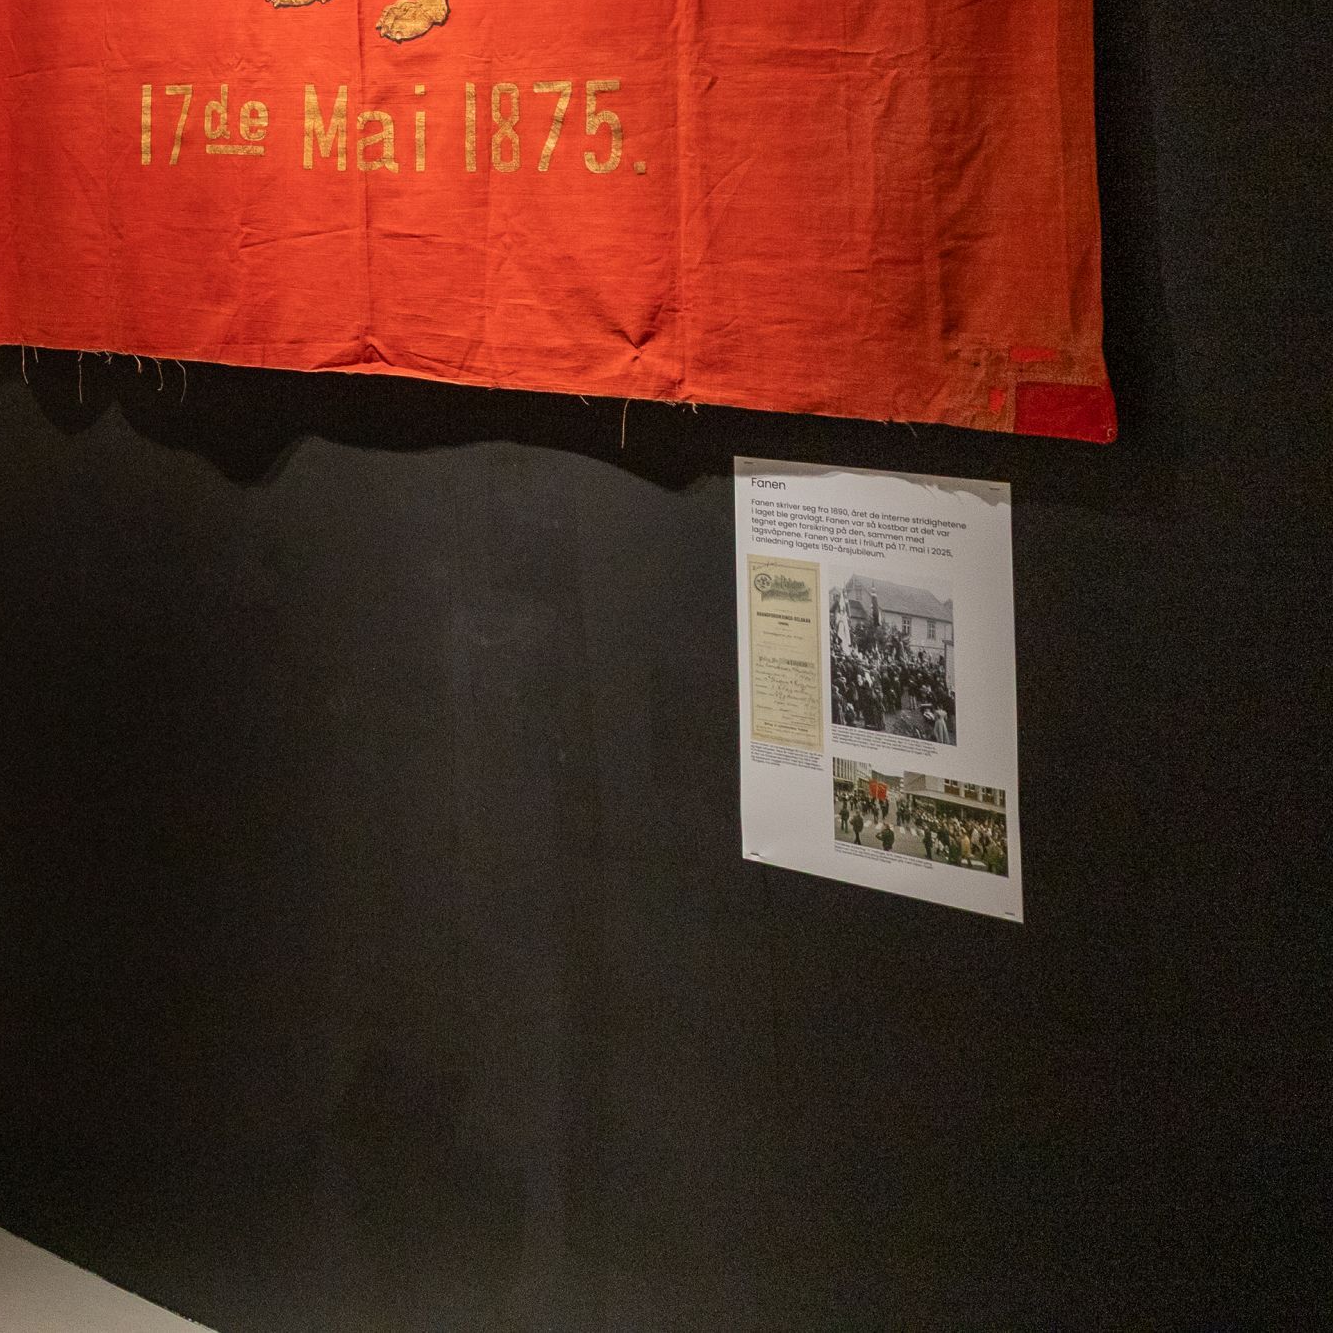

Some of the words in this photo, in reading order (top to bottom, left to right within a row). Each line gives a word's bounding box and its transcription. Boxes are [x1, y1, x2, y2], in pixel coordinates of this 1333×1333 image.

[140, 83, 269, 166] 17de
[303, 83, 426, 174] Mai
[464, 80, 647, 174] 1875.
[751, 478, 785, 489] Fanen
[751, 498, 774, 507] Fanen
[776, 502, 800, 510] skriver
[802, 506, 816, 514] seg
[851, 509, 867, 518] året
[881, 513, 910, 523] interne
[912, 518, 966, 529] stridighetene
[755, 508, 774, 517] laget
[776, 510, 788, 518] ble
[825, 516, 849, 525] Fanen
[877, 522, 907, 532] kostbar
[920, 527, 934, 535] det
[751, 517, 776, 526] tegnet
[777, 521, 797, 529] egen
[799, 522, 834, 534] forsikring
[836, 527, 846, 535] på
[867, 532, 903, 541] sammen
[755, 536, 793, 548] anledning
[795, 540, 819, 550] lagets
[804, 532, 828, 541] Fanen
[844, 537, 857, 545] sist
[863, 539, 883, 548] friluft
[885, 542, 896, 551] på
